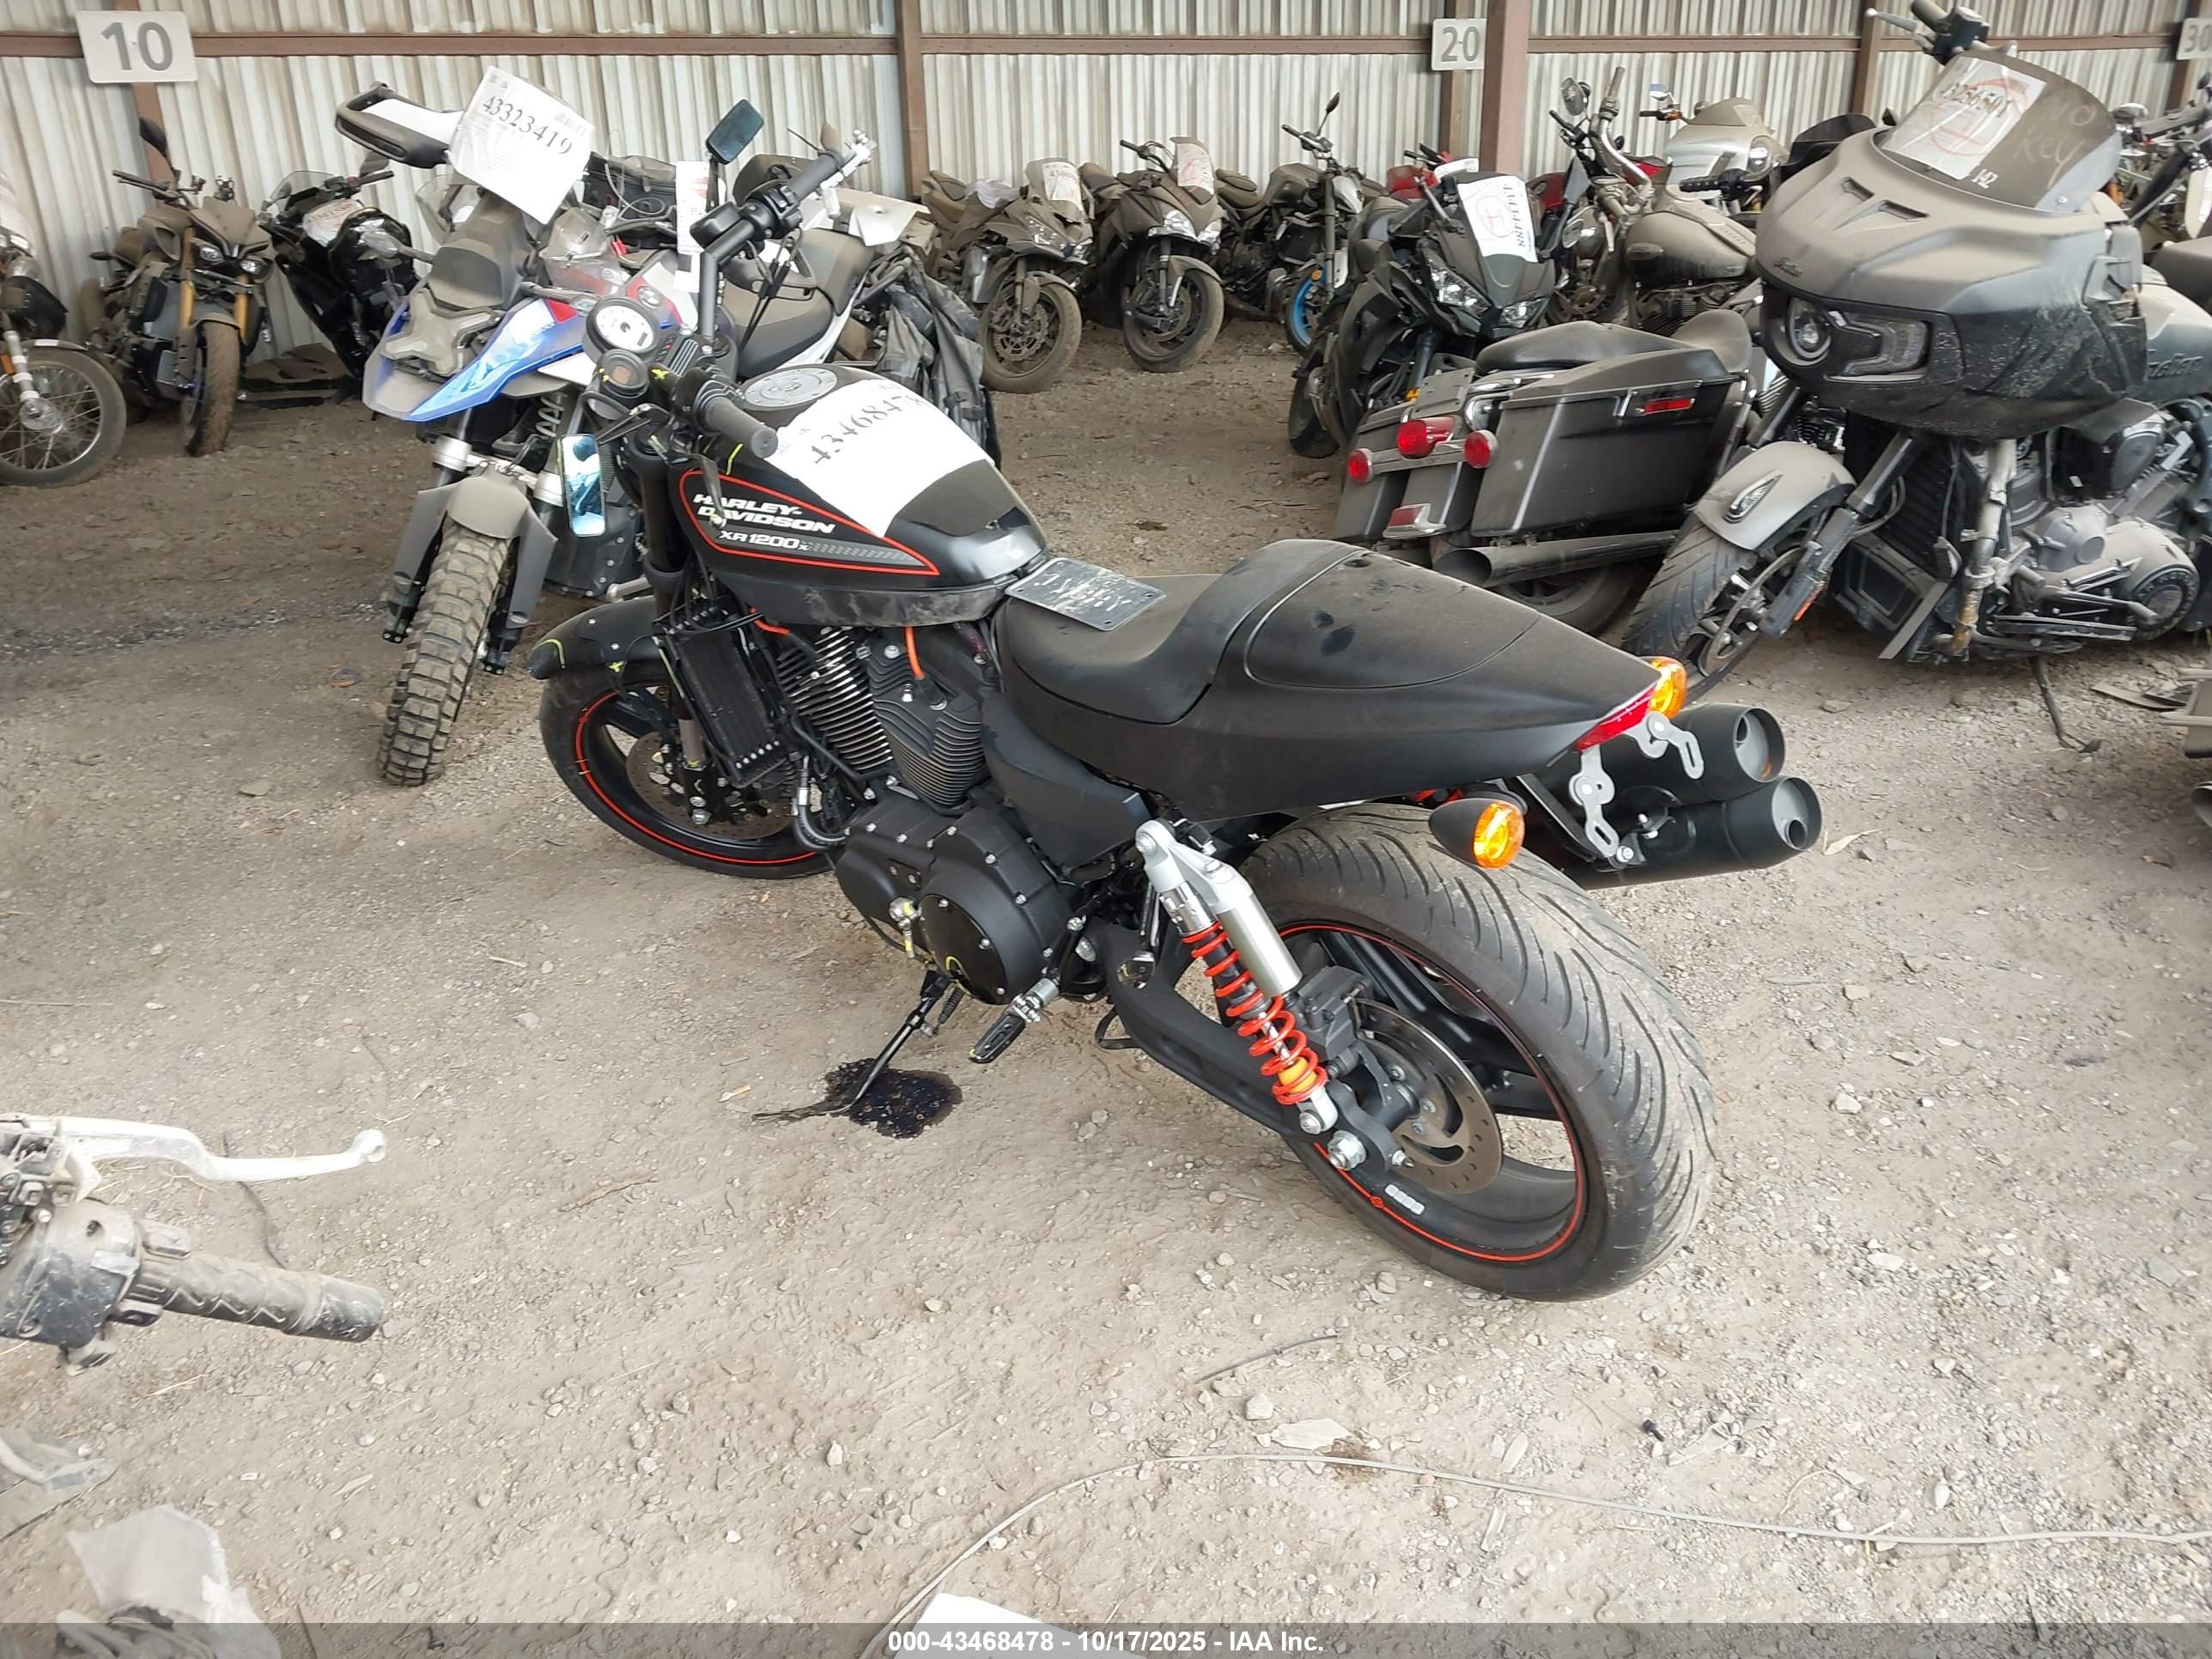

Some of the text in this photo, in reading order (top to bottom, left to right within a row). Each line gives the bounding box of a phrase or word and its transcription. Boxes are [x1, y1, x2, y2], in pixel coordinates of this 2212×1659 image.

[101, 21, 173, 71] 10
[1441, 26, 1480, 62] 20
[2184, 24, 2212, 52] 30
[483, 95, 573, 155] 43323419
